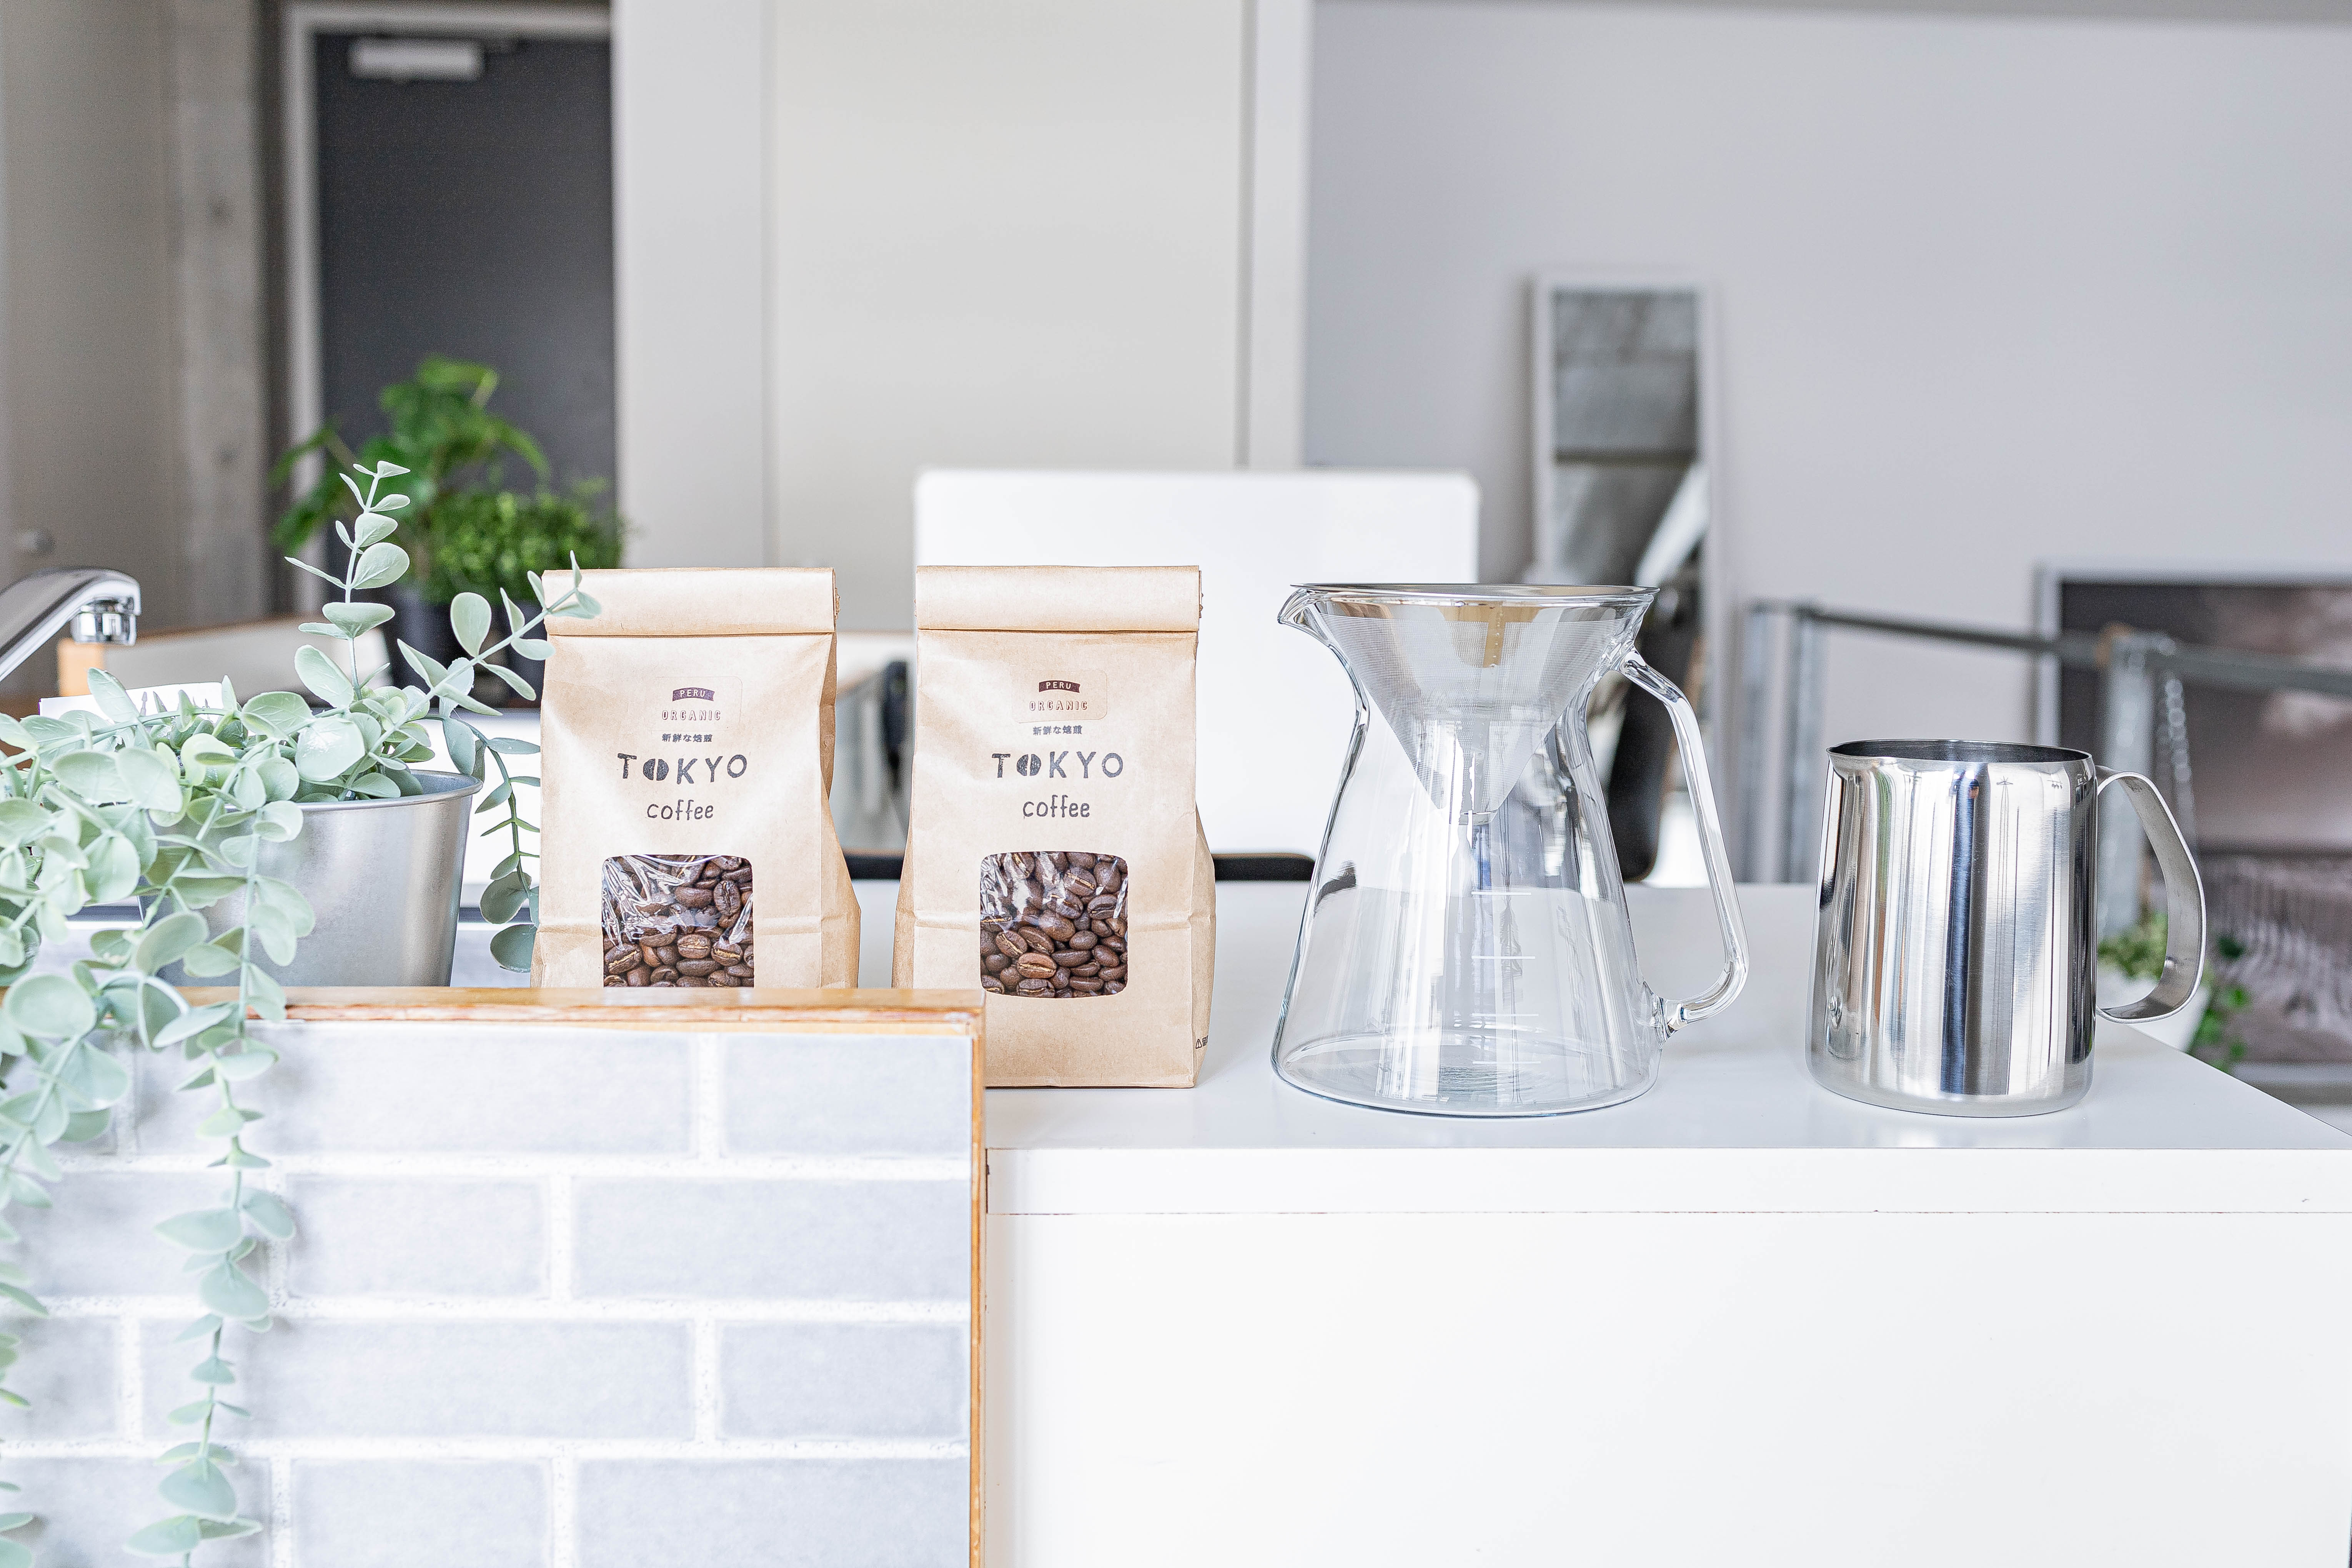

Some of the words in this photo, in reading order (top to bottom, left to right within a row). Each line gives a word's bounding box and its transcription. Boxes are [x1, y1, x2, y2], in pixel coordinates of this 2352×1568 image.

[1045, 681, 1072, 690] PERU
[679, 689, 706, 698] PERU
[1030, 701, 1087, 711] ORGANIC
[662, 710, 720, 721] ORGANIC
[1033, 725, 1082, 735] 新鮮な焙煎
[662, 734, 712, 742] 新鮮な焙煎
[618, 753, 747, 784] TOKYO
[992, 751, 1123, 778] TOKYO
[647, 799, 713, 821] coffee
[1023, 795, 1090, 819] coffee
